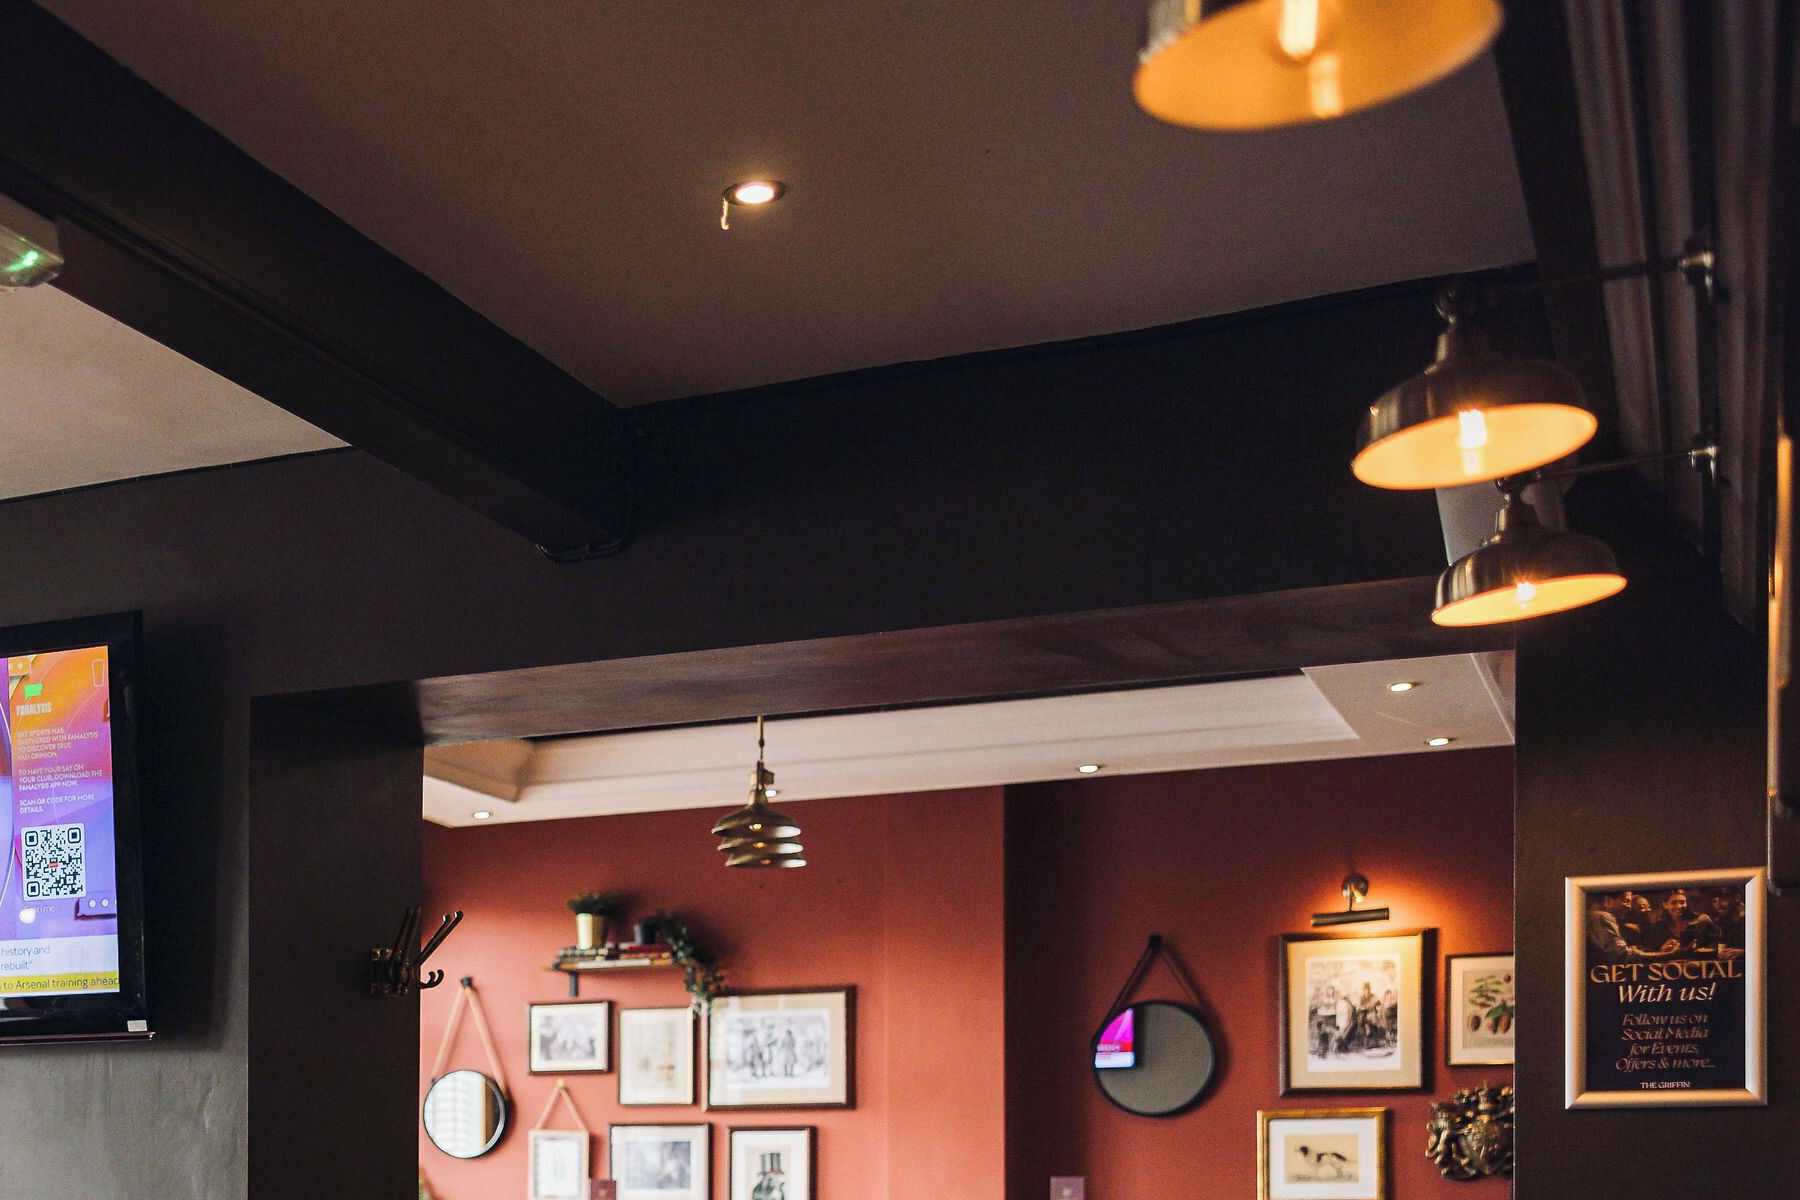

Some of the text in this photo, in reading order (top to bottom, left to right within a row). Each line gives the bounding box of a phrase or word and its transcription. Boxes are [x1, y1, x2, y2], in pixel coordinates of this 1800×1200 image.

[17, 702, 52, 716] FANALYSIS
[68, 731, 99, 741] FANALYSIS
[55, 772, 90, 781] DOWNLOAD
[19, 783, 49, 791] FANALYSIS
[20, 799, 36, 807] SCAN
[46, 796, 63, 804] CODE
[78, 793, 95, 801] MORE
[1, 946, 31, 957] history
[34, 945, 51, 954] and
[1590, 960, 1742, 983] GET SOCIAL
[4, 981, 13, 990] to
[16, 979, 50, 989] Arsenal
[52, 977, 88, 989] training
[1618, 982, 1717, 1004] With us!
[1622, 1014, 1709, 1027] Follow us on
[1621, 1027, 1710, 1041] Social Media
[1630, 1043, 1650, 1057] for
[1615, 1057, 1656, 1073] Offers
[1658, 1057, 1670, 1069] &
[1658, 1081, 1691, 1089] GRIFFIN
